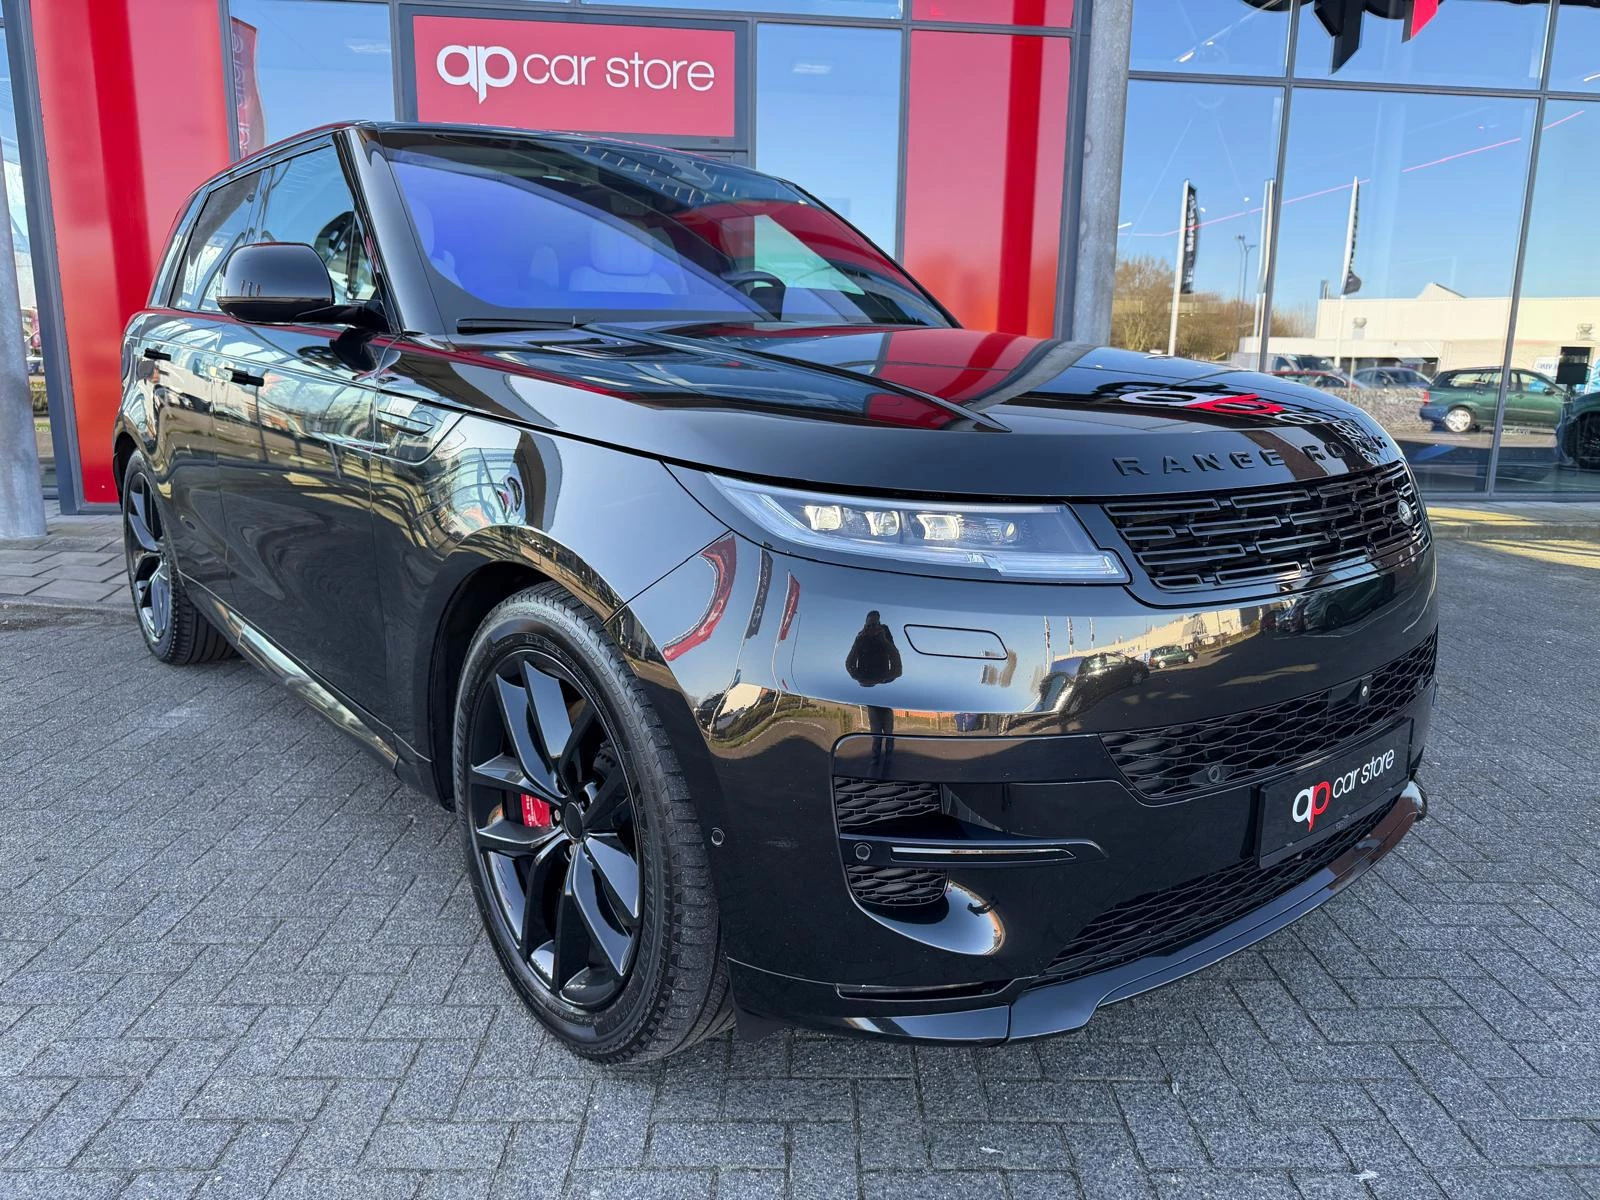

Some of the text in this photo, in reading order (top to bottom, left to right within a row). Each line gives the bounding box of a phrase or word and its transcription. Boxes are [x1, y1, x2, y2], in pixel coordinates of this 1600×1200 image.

[436, 44, 715, 104] ap car store
[1112, 448, 1286, 476] RANGE
[1292, 780, 1331, 832] ap
[1332, 766, 1361, 799] car
[1360, 749, 1395, 784] store
